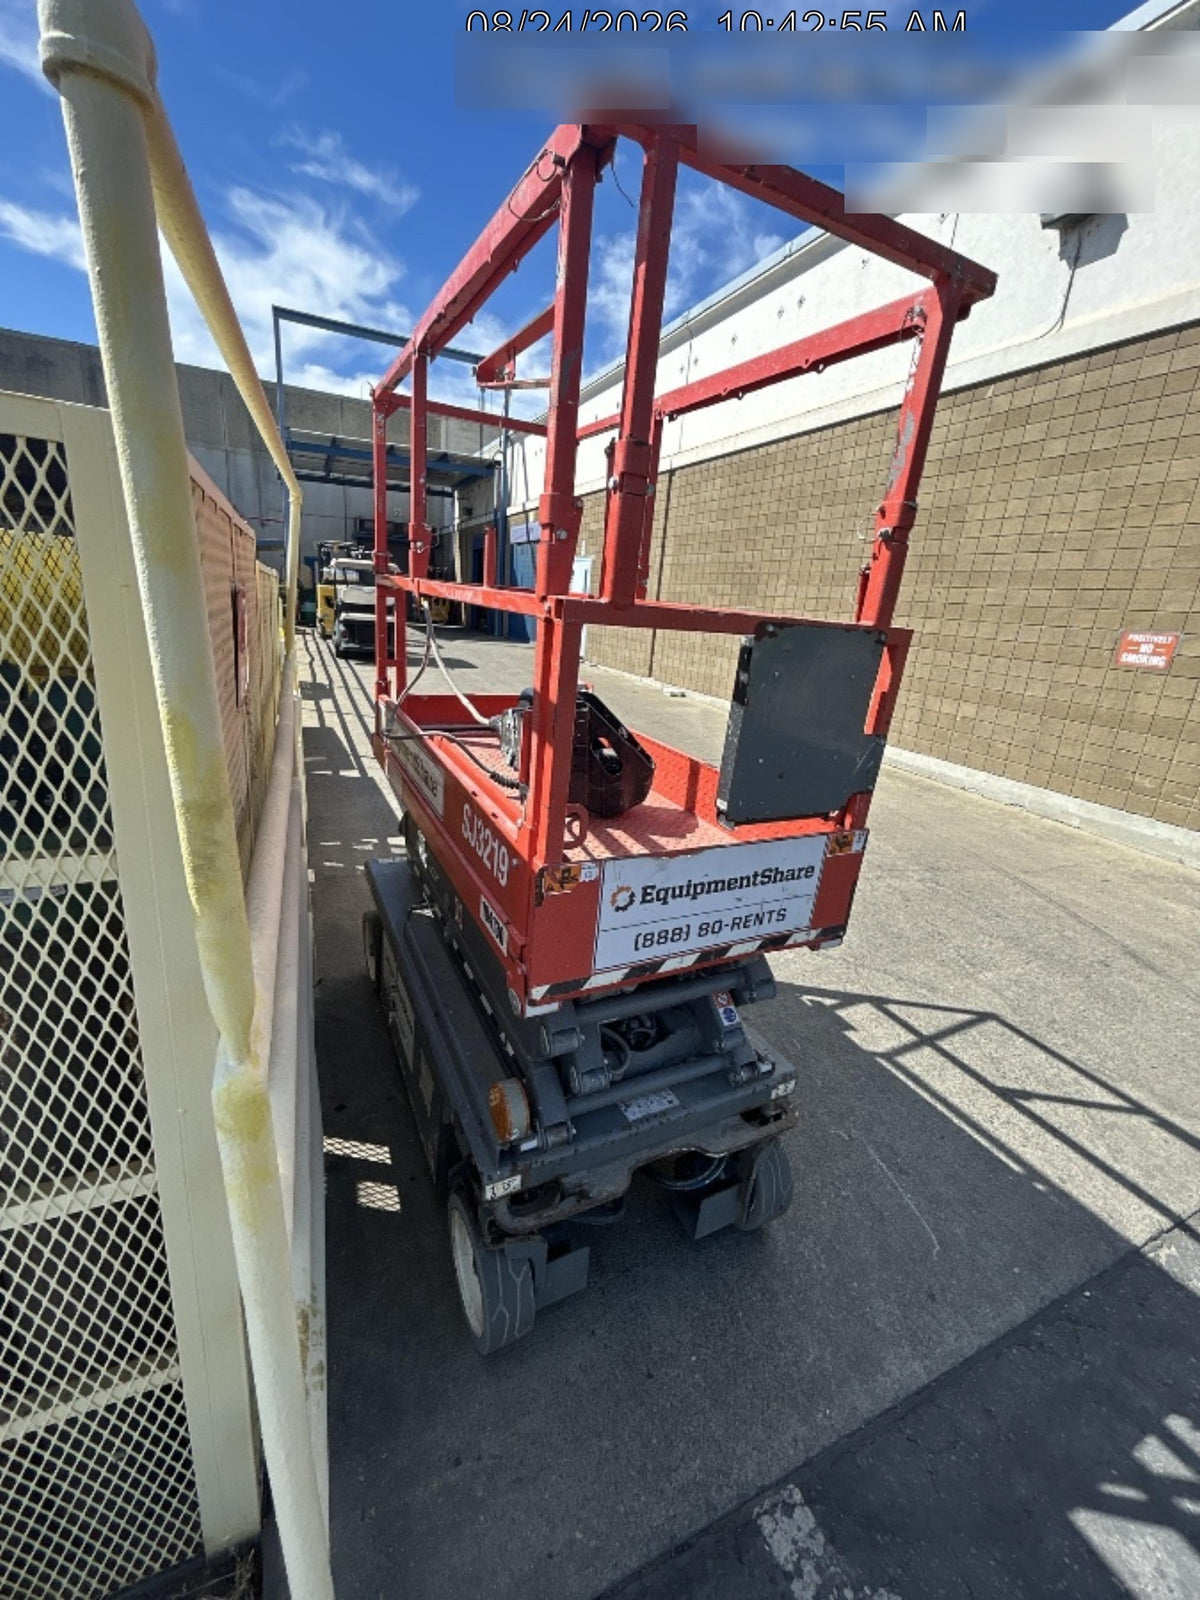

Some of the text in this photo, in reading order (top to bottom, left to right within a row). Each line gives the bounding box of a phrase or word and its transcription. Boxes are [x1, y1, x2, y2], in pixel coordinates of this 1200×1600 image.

[1120, 653, 1167, 666] SMOKING
[1139, 643, 1154, 653] NO
[461, 803, 509, 887] SJ3219
[640, 865, 815, 904] EquipmentShare
[634, 908, 787, 951] (888) 80-RENTS
